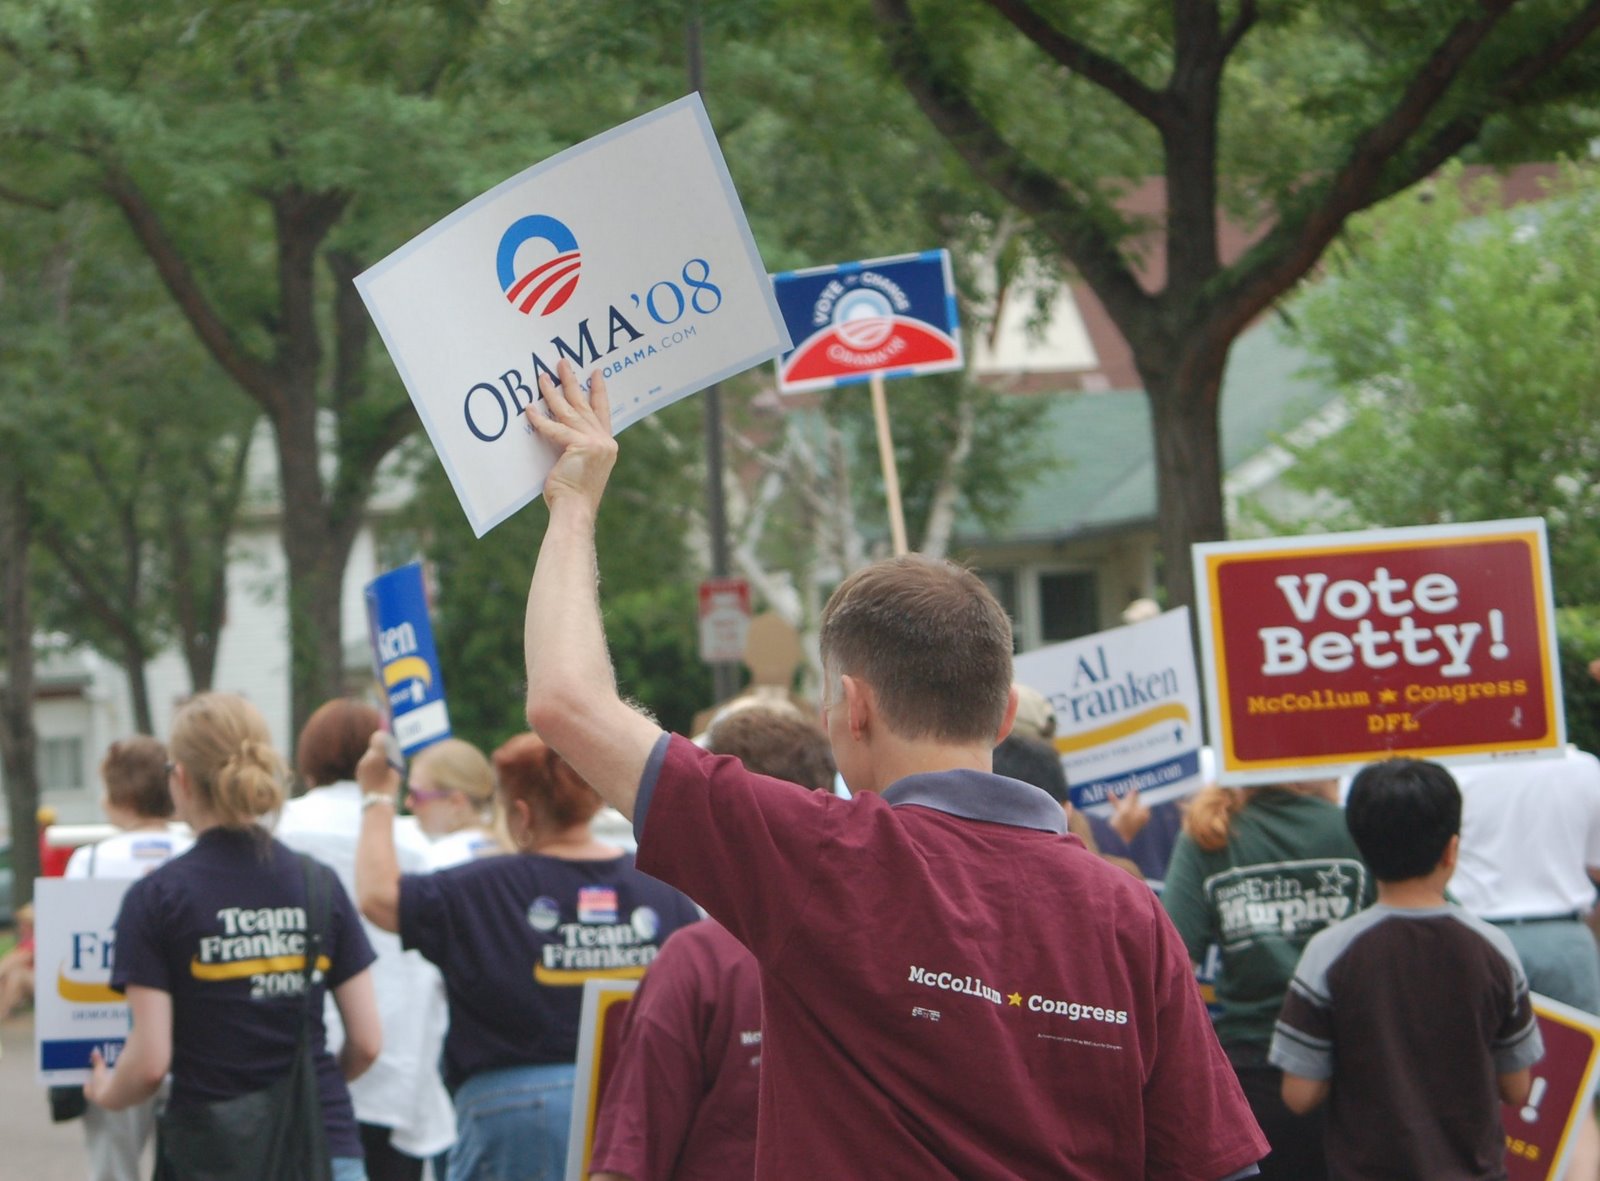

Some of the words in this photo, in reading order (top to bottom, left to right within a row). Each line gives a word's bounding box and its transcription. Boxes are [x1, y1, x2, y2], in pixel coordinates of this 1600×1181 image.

[814, 280, 845, 323] VOTE
[1275, 566, 1459, 622] Vote
[1258, 608, 1510, 677] Betty!
[1073, 645, 1110, 688] Al
[1247, 687, 1371, 714] McCollum
[1404, 679, 1528, 705] Congress
[1366, 711, 1420, 734] DFL
[217, 906, 307, 935] Team
[908, 965, 1002, 1004] McCollum
[1028, 994, 1128, 1024] Congress
